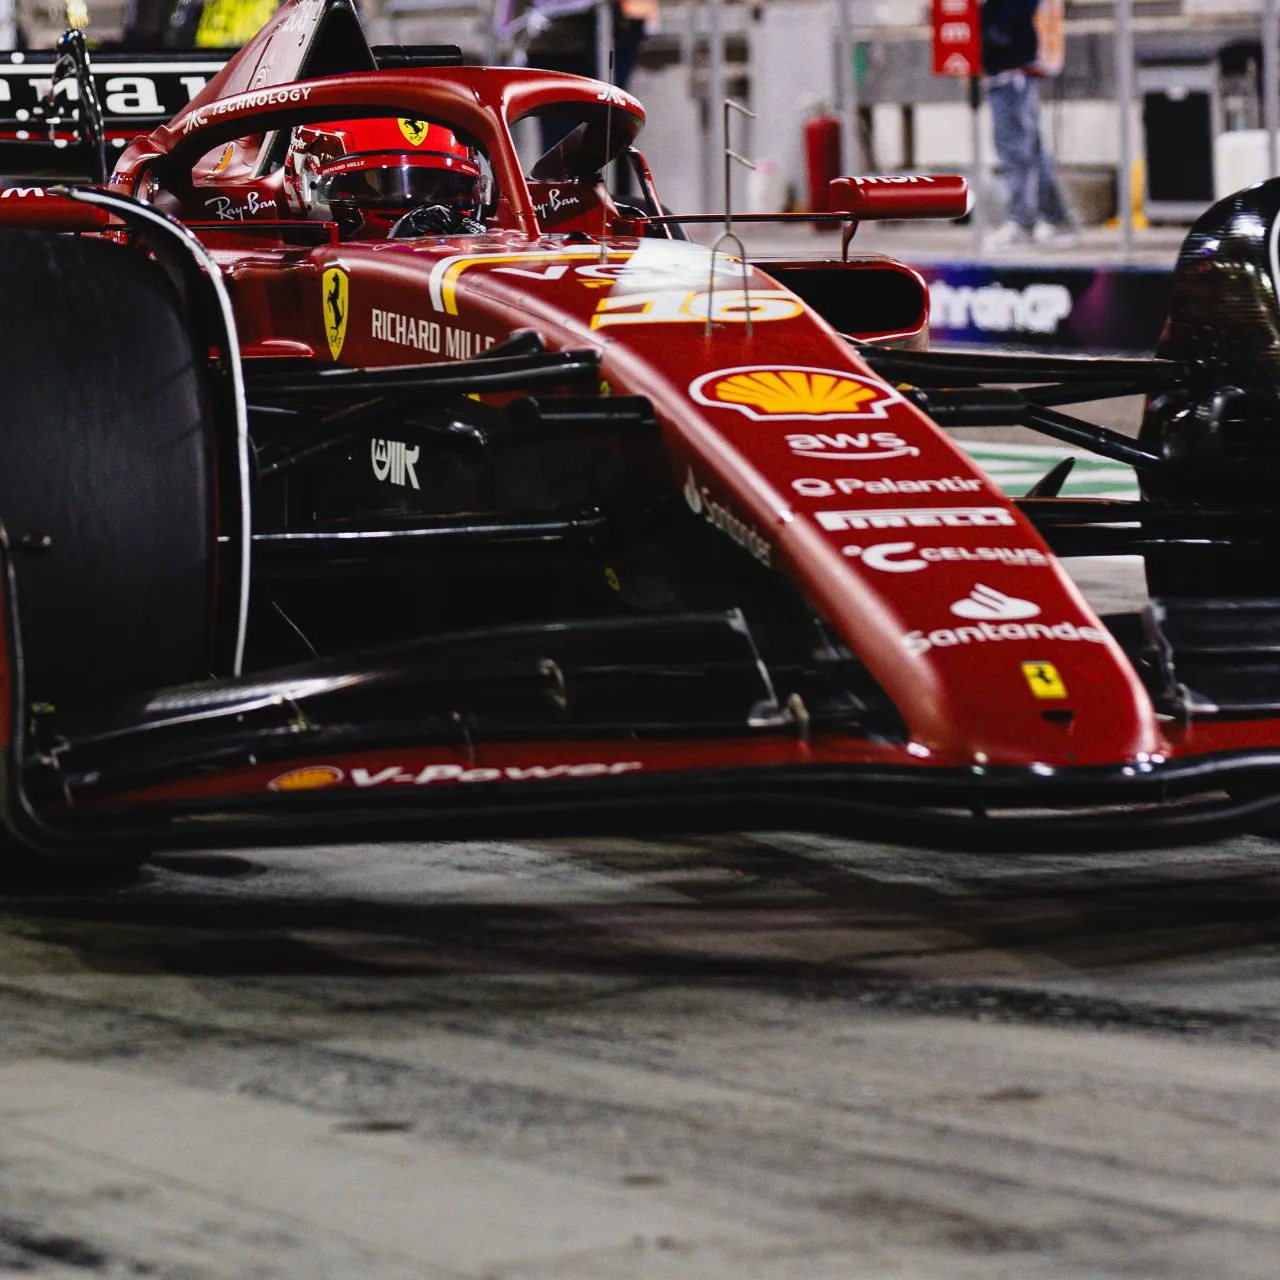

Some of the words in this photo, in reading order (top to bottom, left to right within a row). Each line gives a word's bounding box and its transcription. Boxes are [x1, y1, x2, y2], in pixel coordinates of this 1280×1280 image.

[212, 87, 312, 117] TECHNOLOGY
[590, 289, 804, 331] 16
[371, 308, 440, 354] RICHARD
[785, 432, 907, 449] aws
[835, 476, 983, 495] Palantir
[815, 507, 1016, 531] PIRELLI
[920, 547, 1049, 563] CELSIUS
[352, 761, 643, 787] V-Power
